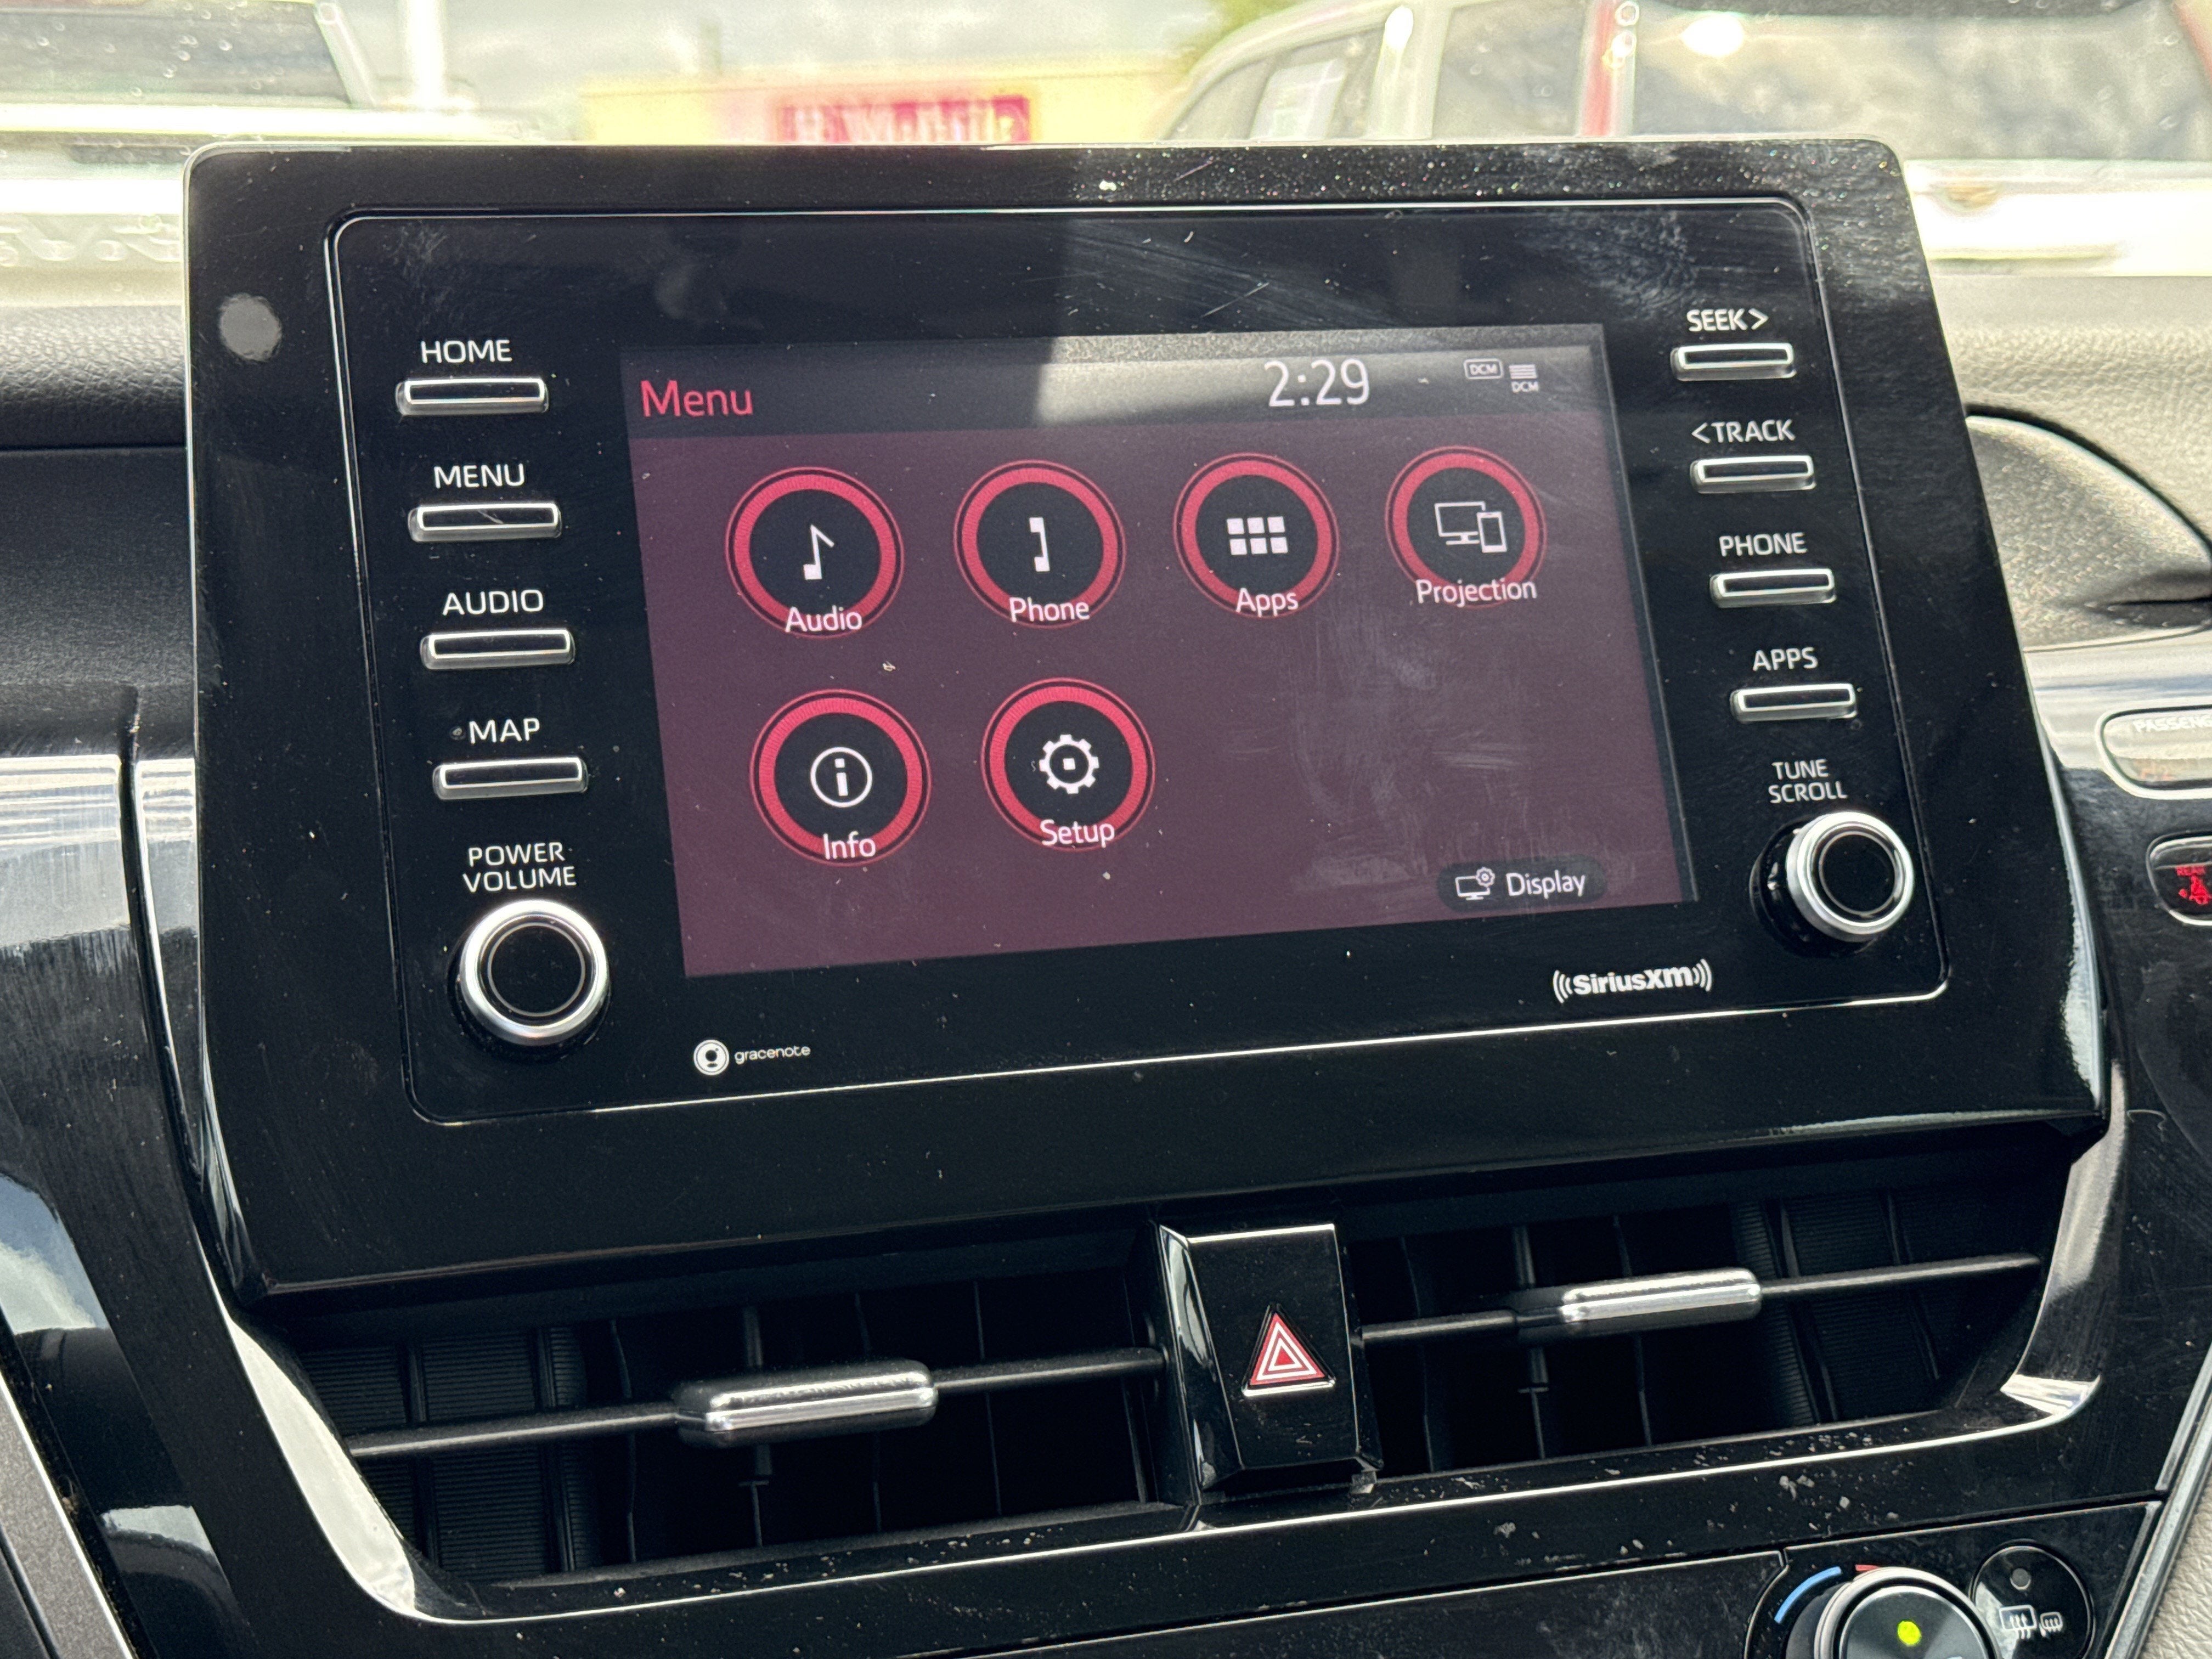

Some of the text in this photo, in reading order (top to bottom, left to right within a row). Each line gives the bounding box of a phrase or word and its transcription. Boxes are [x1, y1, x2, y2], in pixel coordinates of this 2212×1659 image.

[421, 339, 512, 363] HOME
[1264, 358, 1370, 407] 2:29
[1469, 363, 1498, 375] DCM
[640, 379, 753, 417] Menu
[1511, 381, 1539, 393] DCM
[433, 463, 525, 489] MENU
[1719, 532, 1808, 557] PHONE
[442, 589, 544, 616] AUDIO
[1235, 586, 1299, 618] Apps
[1415, 578, 1537, 607] Projection
[785, 605, 862, 633] Audio
[1009, 596, 1091, 623] Phone
[1752, 646, 1819, 672] APPS
[469, 717, 540, 744] MAP
[1771, 758, 1830, 780] TUNE
[1768, 781, 1848, 804] SCROLL
[823, 831, 877, 860] Info
[1040, 819, 1115, 848] Setup
[468, 842, 566, 867] POWER
[462, 866, 577, 893] VOLUME
[1505, 870, 1586, 899] Display
[734, 1045, 811, 1064] gracenote
